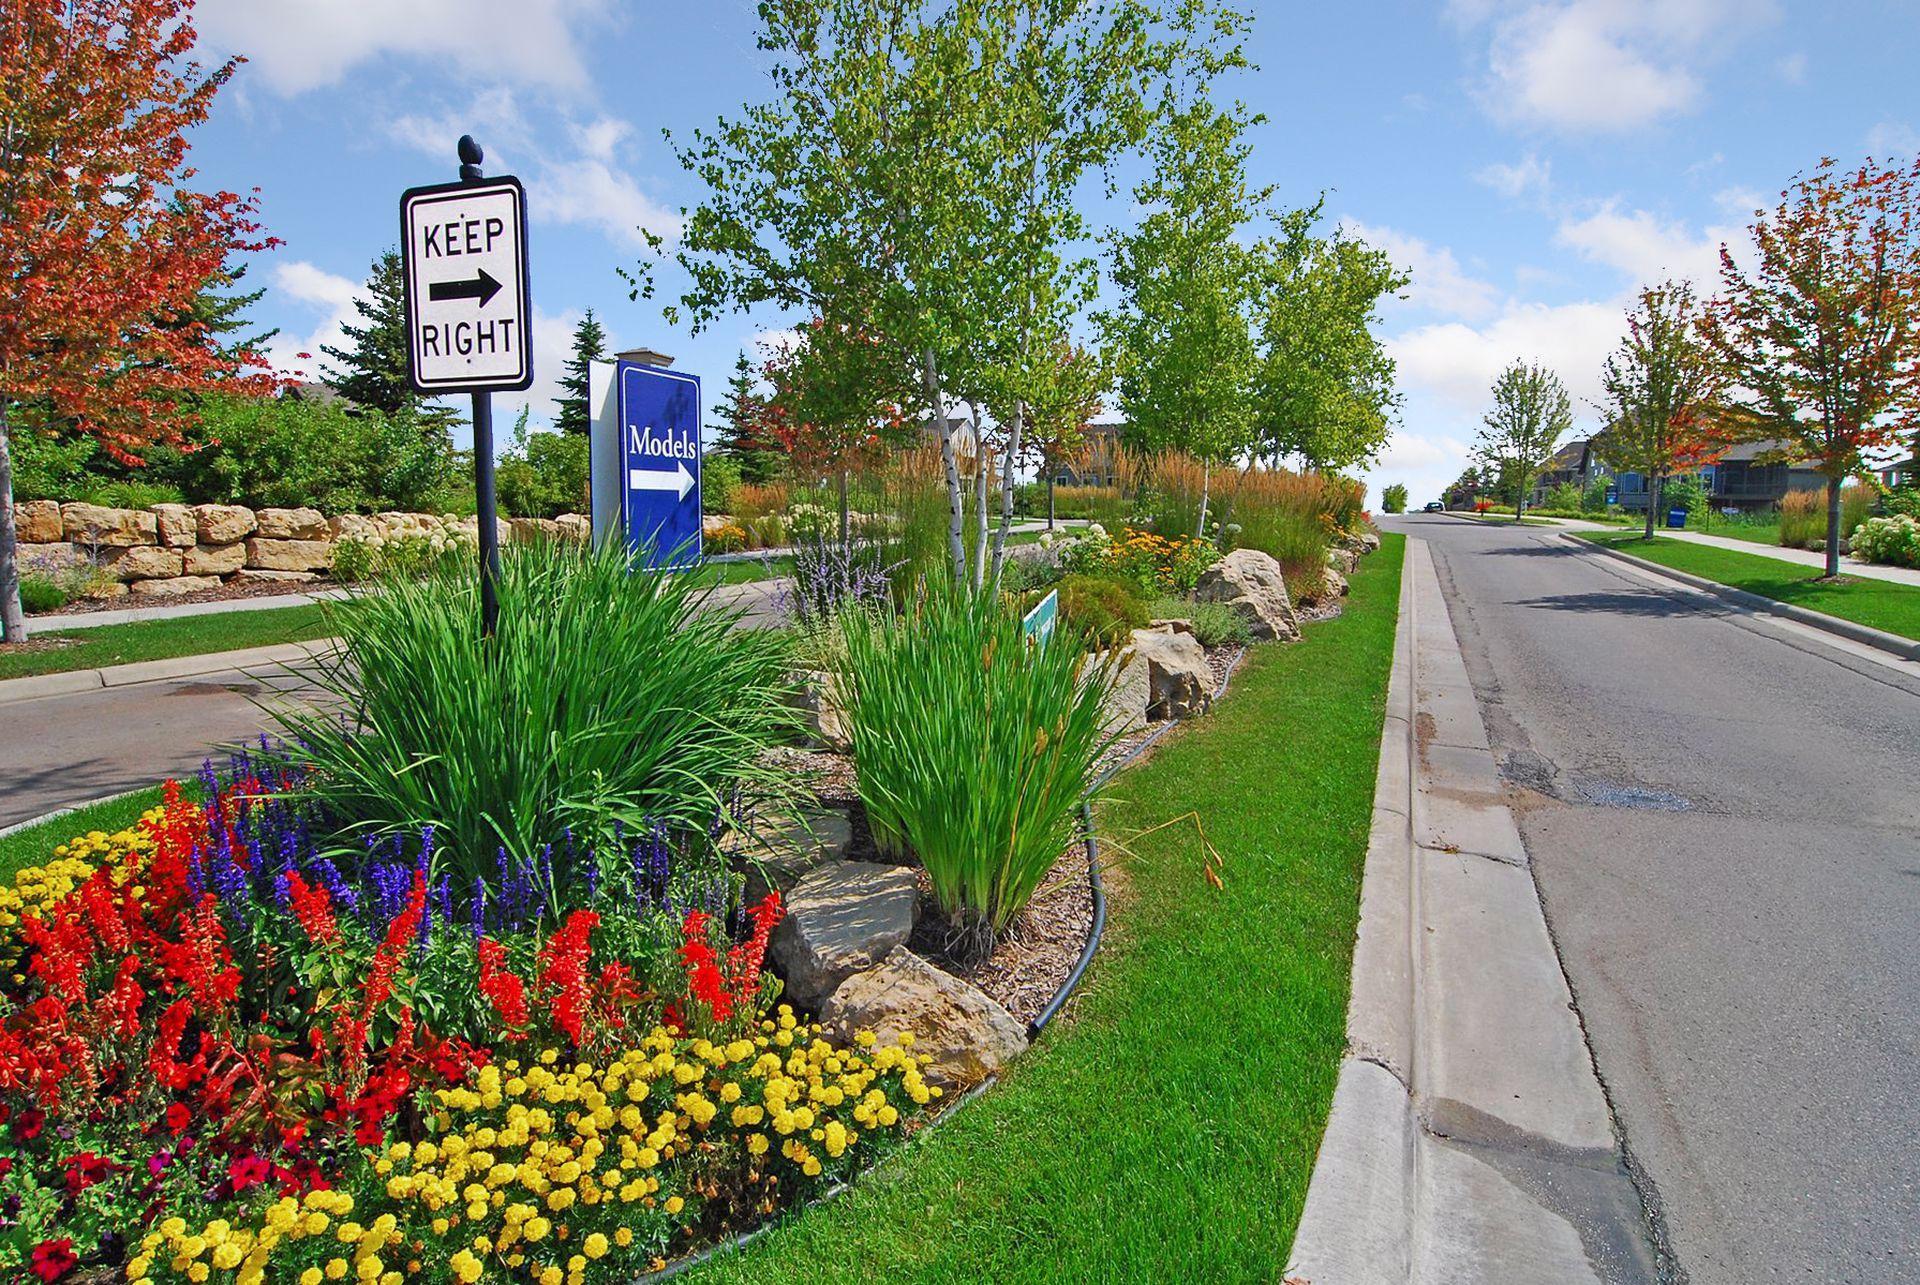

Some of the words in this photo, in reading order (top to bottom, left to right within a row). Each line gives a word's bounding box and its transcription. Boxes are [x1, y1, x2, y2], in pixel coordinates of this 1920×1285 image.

[424, 218, 504, 257] KEEP
[422, 319, 515, 357] RIGHT
[629, 425, 696, 459] Models
